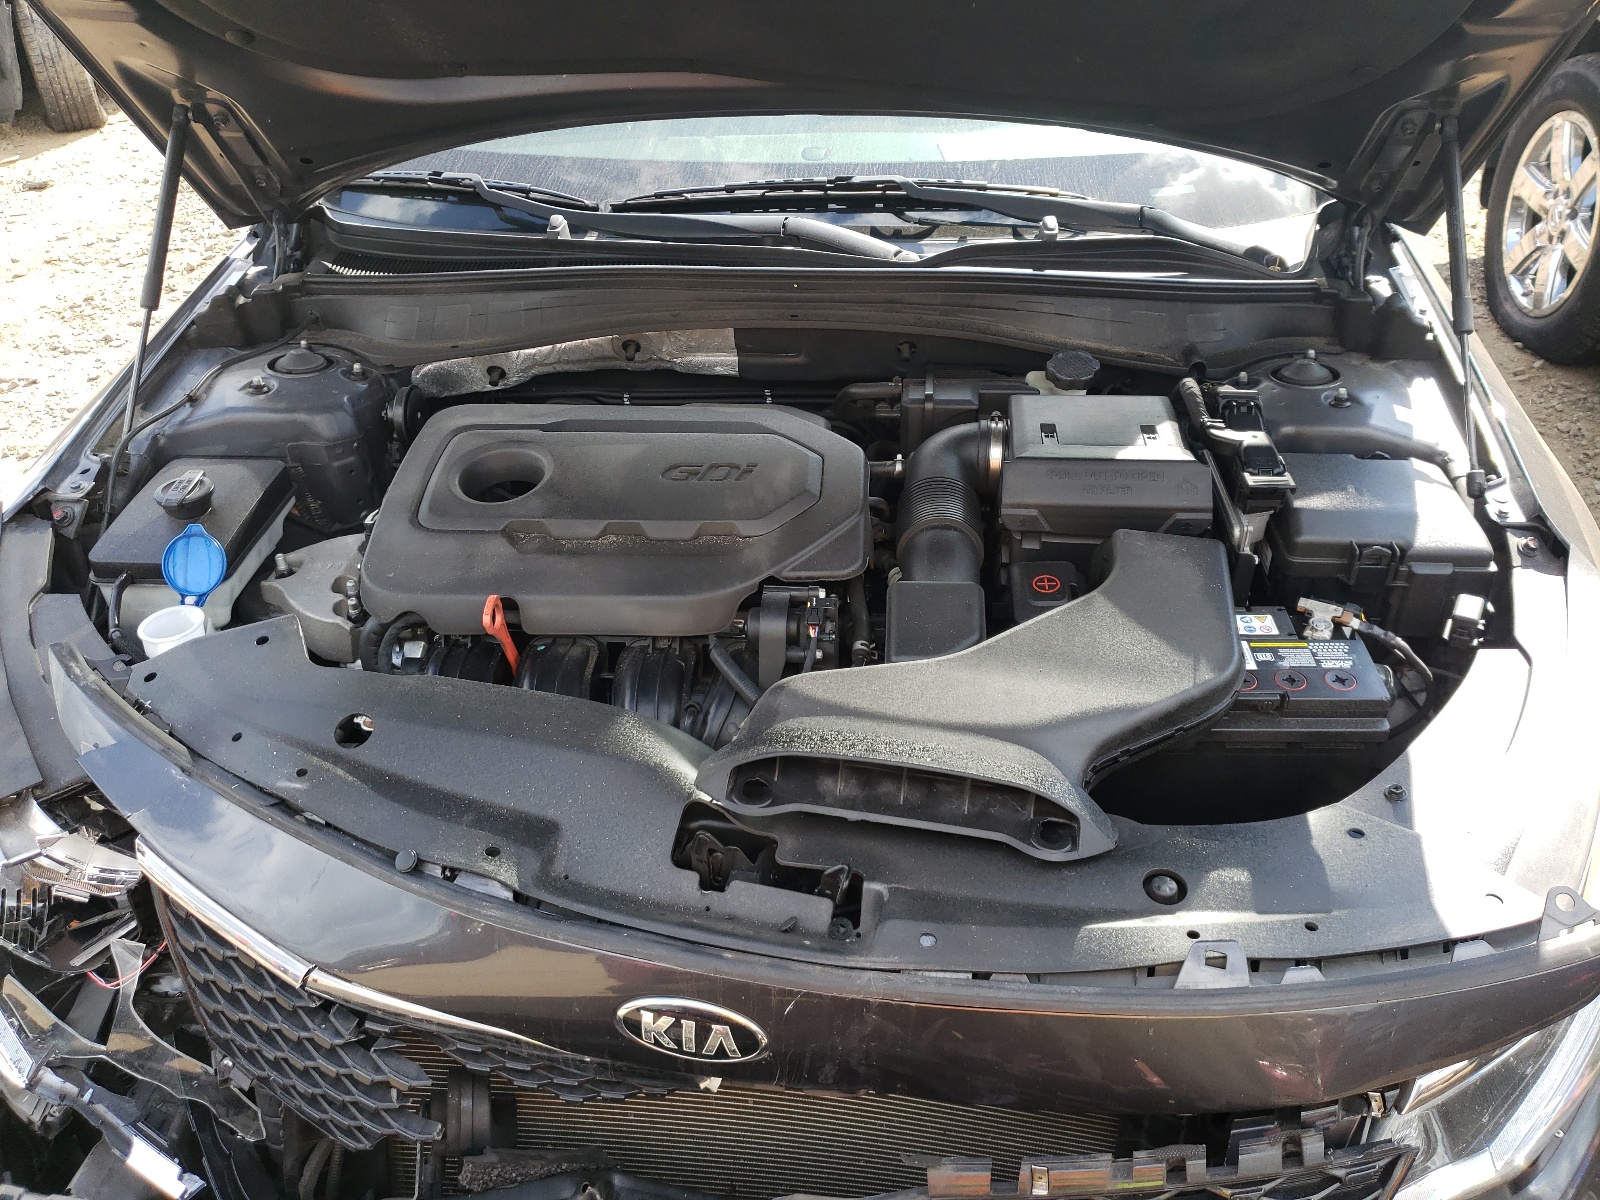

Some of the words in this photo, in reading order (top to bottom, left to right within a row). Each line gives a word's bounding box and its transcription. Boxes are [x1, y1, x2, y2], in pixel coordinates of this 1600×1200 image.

[1084, 471, 1108, 481] OUT
[1112, 471, 1128, 481] TO
[1132, 471, 1166, 482] OPEN
[640, 1009, 742, 1058] KIA
